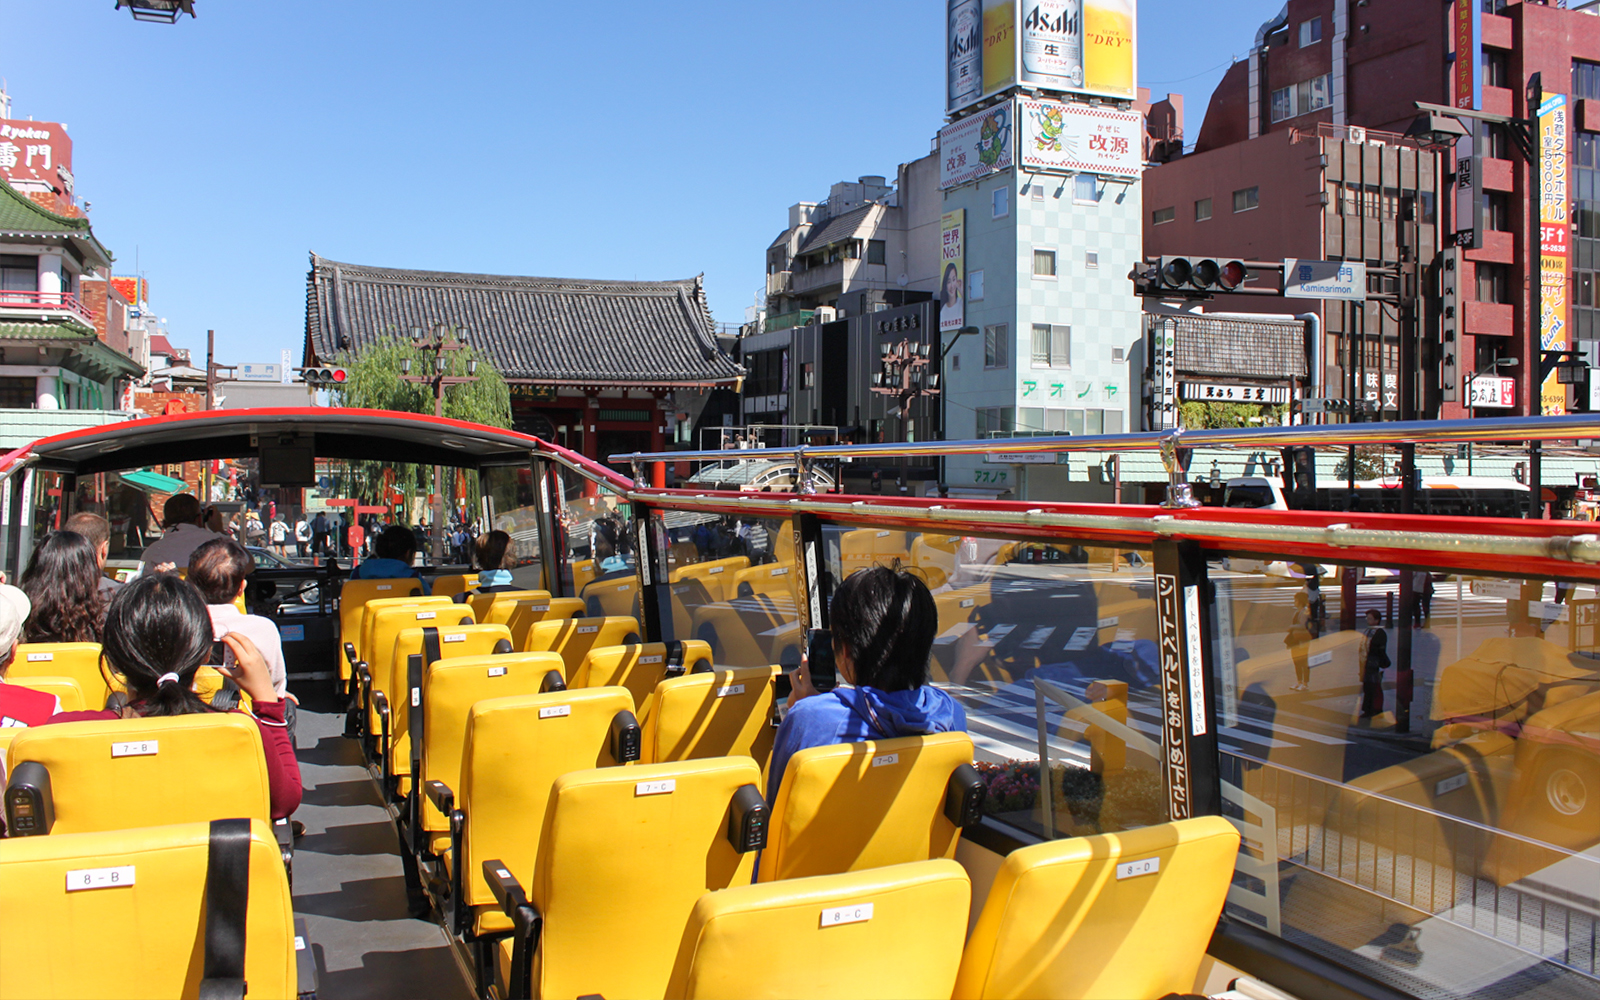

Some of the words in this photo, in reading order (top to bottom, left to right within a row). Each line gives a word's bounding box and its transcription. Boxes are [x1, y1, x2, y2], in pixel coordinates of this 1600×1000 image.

[1025, 5, 1078, 37] Asahi
[1044, 44, 1060, 56] 生
[1037, 56, 1068, 66] スーパードライ
[960, 64, 969, 78] 生
[1458, 96, 1471, 108] 5F
[0, 124, 50, 140] Ryokan
[1097, 124, 1120, 134] かぜに
[1088, 133, 1129, 155] 改源
[0, 142, 52, 171] 雷門
[946, 152, 967, 172] 改源
[1097, 152, 1121, 161] カイゲン
[1554, 110, 1566, 220] 浅草タウンホテル
[1458, 158, 1471, 188] 和民
[942, 228, 959, 246] 世界
[942, 243, 960, 260] No.1
[1298, 265, 1353, 283] 雷門
[1300, 283, 1352, 294] Kaminarimon
[1023, 381, 1117, 400] アオノヤ
[1502, 381, 1514, 393] 1F
[975, 470, 1007, 483] アオノヤ
[1159, 577, 1189, 820] シートベルトをおしめ下さい
